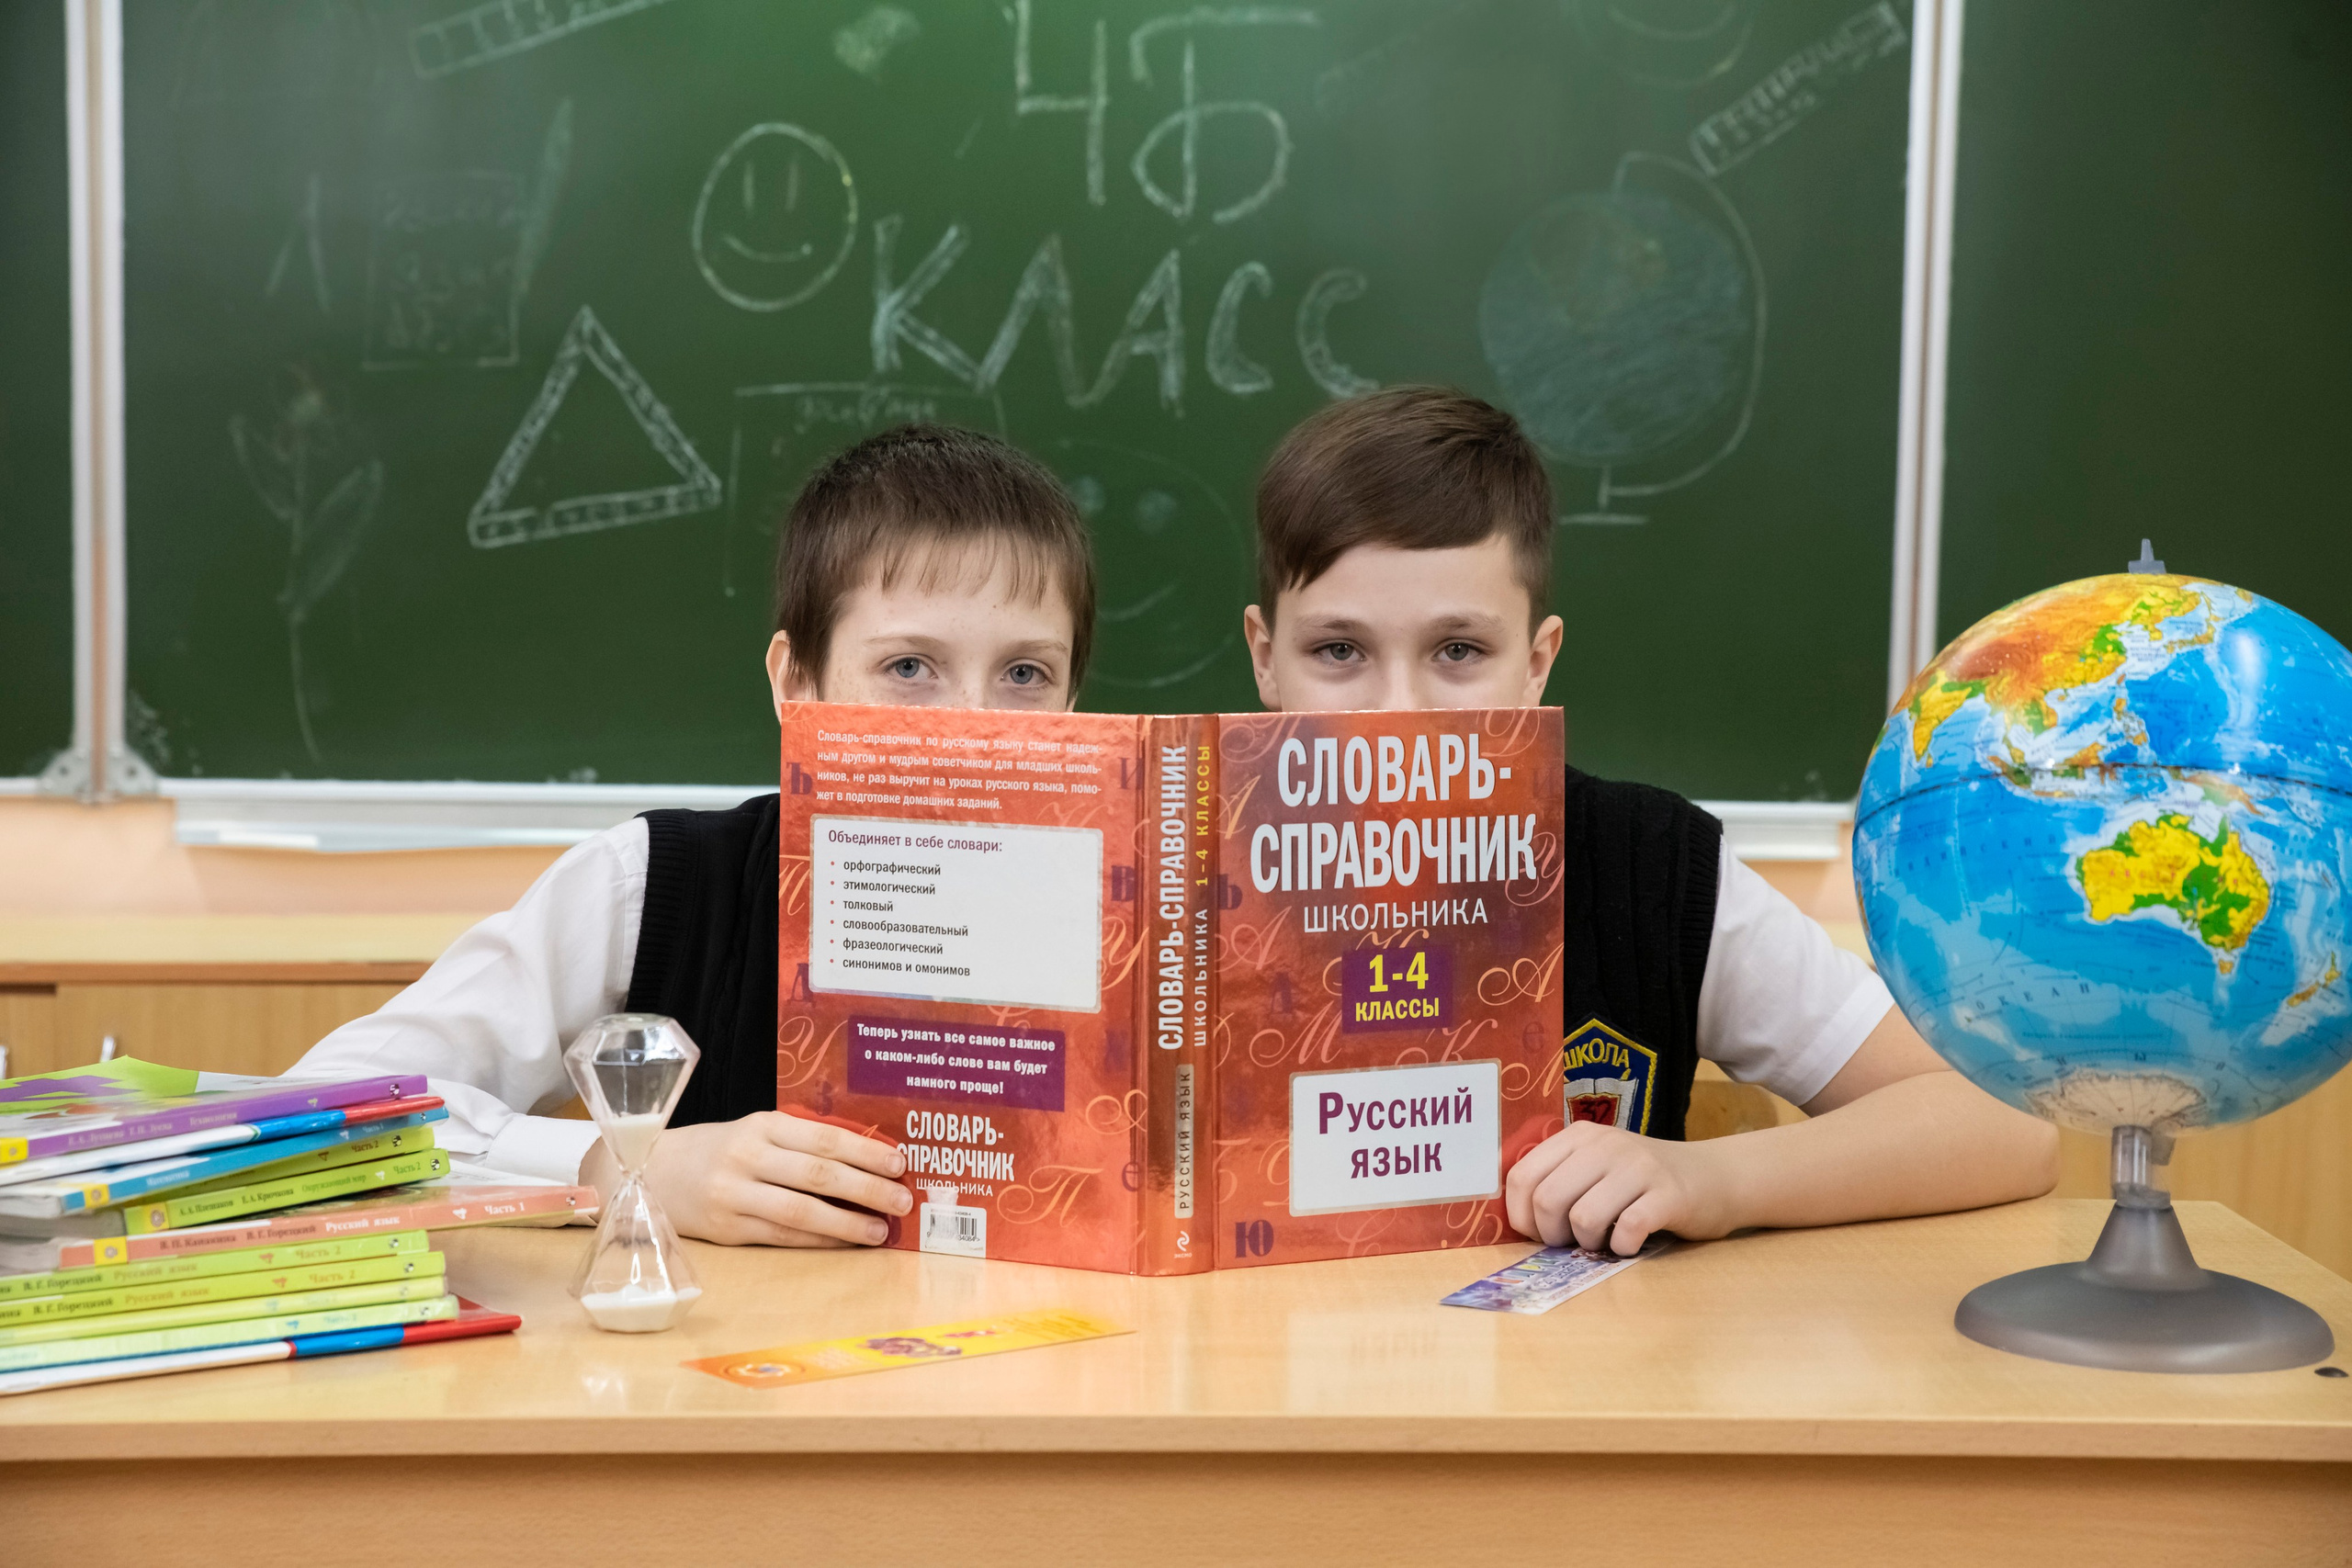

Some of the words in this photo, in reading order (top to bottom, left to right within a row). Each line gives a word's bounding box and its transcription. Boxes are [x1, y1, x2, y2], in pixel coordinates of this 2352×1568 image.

[871, 214, 1380, 418] КЛАСС
[818, 729, 922, 747] Словарь-справочник
[926, 737, 938, 747] по
[943, 737, 989, 751] русскому
[993, 739, 1023, 752] языку
[1028, 740, 1061, 752] станет
[1066, 743, 1102, 755] надеж-
[818, 751, 839, 761] ным
[842, 753, 876, 765] другом
[879, 755, 886, 764] и
[889, 755, 929, 767] мудрым
[933, 757, 991, 769] советчиком
[995, 760, 1012, 771] для
[1016, 761, 1062, 773] младших
[1066, 763, 1102, 774] школь-
[1278, 733, 1512, 807] СЛОВАРЬ-
[818, 772, 850, 784] ников,
[854, 773, 865, 783] не
[868, 773, 887, 785] раз
[889, 775, 931, 787] выручит
[933, 777, 945, 787] на
[949, 778, 982, 790] уроках
[986, 780, 1030, 792] русского
[1033, 782, 1068, 795] языка,
[1071, 784, 1102, 795] помо-
[1196, 746, 1210, 836] КЛАССЫ
[817, 791, 834, 801] жет
[837, 792, 843, 801] в
[845, 792, 900, 804] подготовке
[903, 795, 955, 807] домашних
[957, 796, 1002, 810] заданий.
[828, 829, 900, 847] Объединяет
[904, 835, 912, 847] в
[916, 834, 944, 849] себе
[947, 838, 1002, 855] словари:
[1250, 813, 1537, 894] СПРАВОЧНИК
[843, 860, 941, 875] орфографический
[842, 880, 935, 896] этимологический
[1158, 745, 1187, 1050] СЛОВАРЬ-СПРАВОЧНИК
[842, 899, 894, 912] толковый
[1304, 897, 1488, 933] ШКОЛЬНИКА
[842, 919, 968, 937] словообразовательный
[842, 938, 944, 955] фразеологический
[842, 958, 902, 973] синонимов
[906, 962, 912, 973] и
[915, 963, 971, 976] омонимов
[1194, 908, 1208, 1047] ШКОЛЬНИКА
[1369, 952, 1429, 993] 1-4
[1355, 997, 1440, 1022] КЛАССЫ
[857, 1023, 899, 1040] Теперь
[900, 1028, 941, 1043] узнать
[944, 1032, 966, 1044] все
[968, 1033, 1006, 1048] самое
[1010, 1037, 1056, 1052] важное
[865, 1050, 872, 1060] о
[876, 1049, 944, 1066] каком-либо
[948, 1055, 984, 1069] слове
[987, 1059, 1011, 1072] вам
[1013, 1059, 1047, 1076] будет
[906, 1075, 956, 1090] намного
[960, 1079, 1004, 1096] проще!
[1180, 1073, 1191, 1121] ЯЗЫК
[906, 1110, 1004, 1145] СЛОВАРЬ-
[1180, 1131, 1191, 1210] РУССКИЙ
